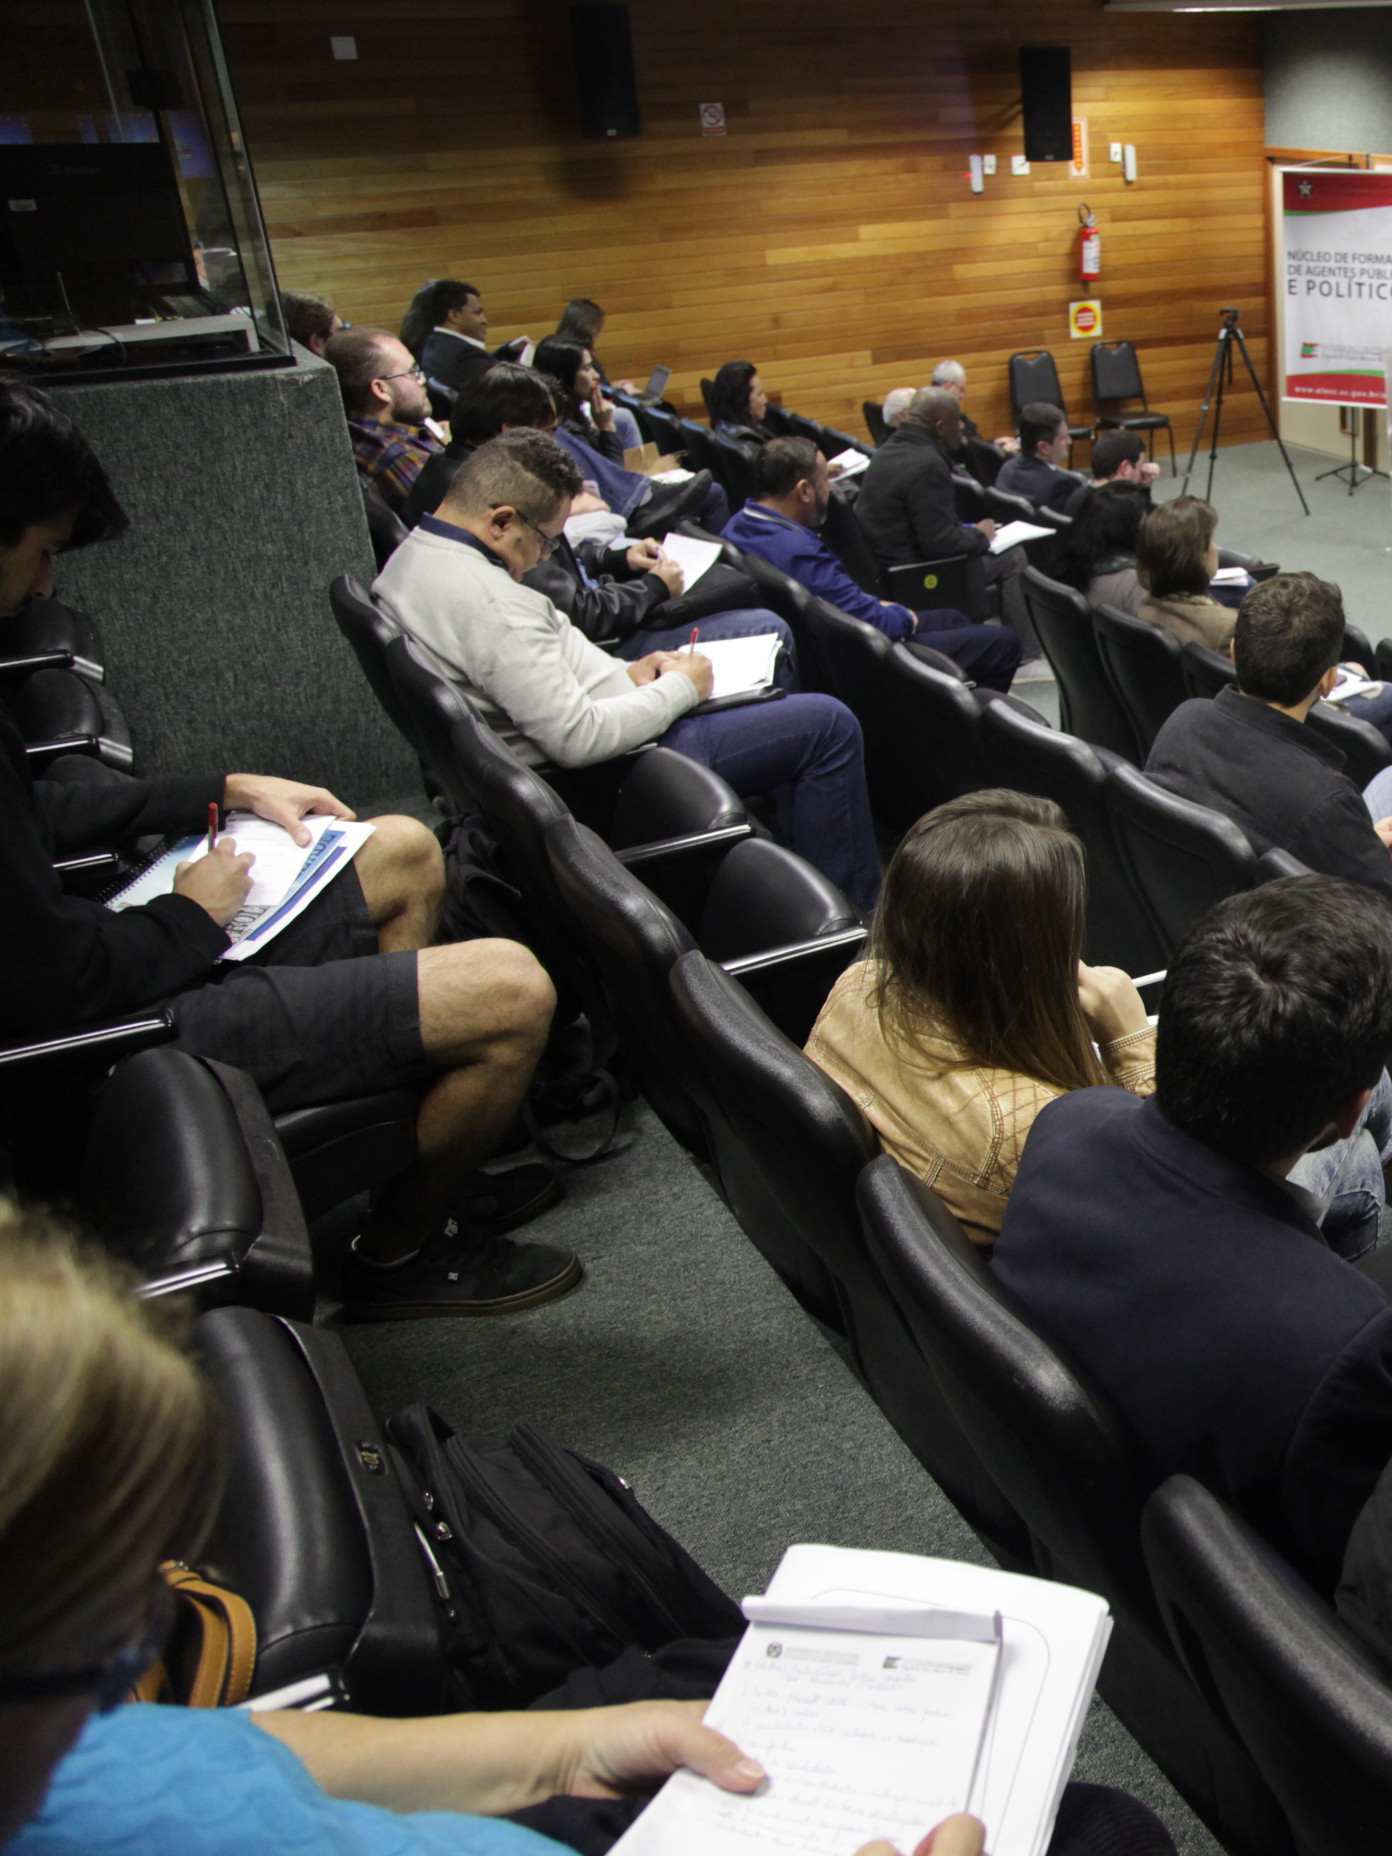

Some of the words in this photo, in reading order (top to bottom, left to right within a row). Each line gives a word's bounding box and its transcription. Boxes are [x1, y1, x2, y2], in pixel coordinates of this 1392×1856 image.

[1287, 249, 1331, 262] NÚCLEO
[1334, 253, 1349, 262] DE
[1287, 265, 1304, 275] DE
[1305, 266, 1357, 278] AGENTES
[1288, 279, 1298, 294] E
